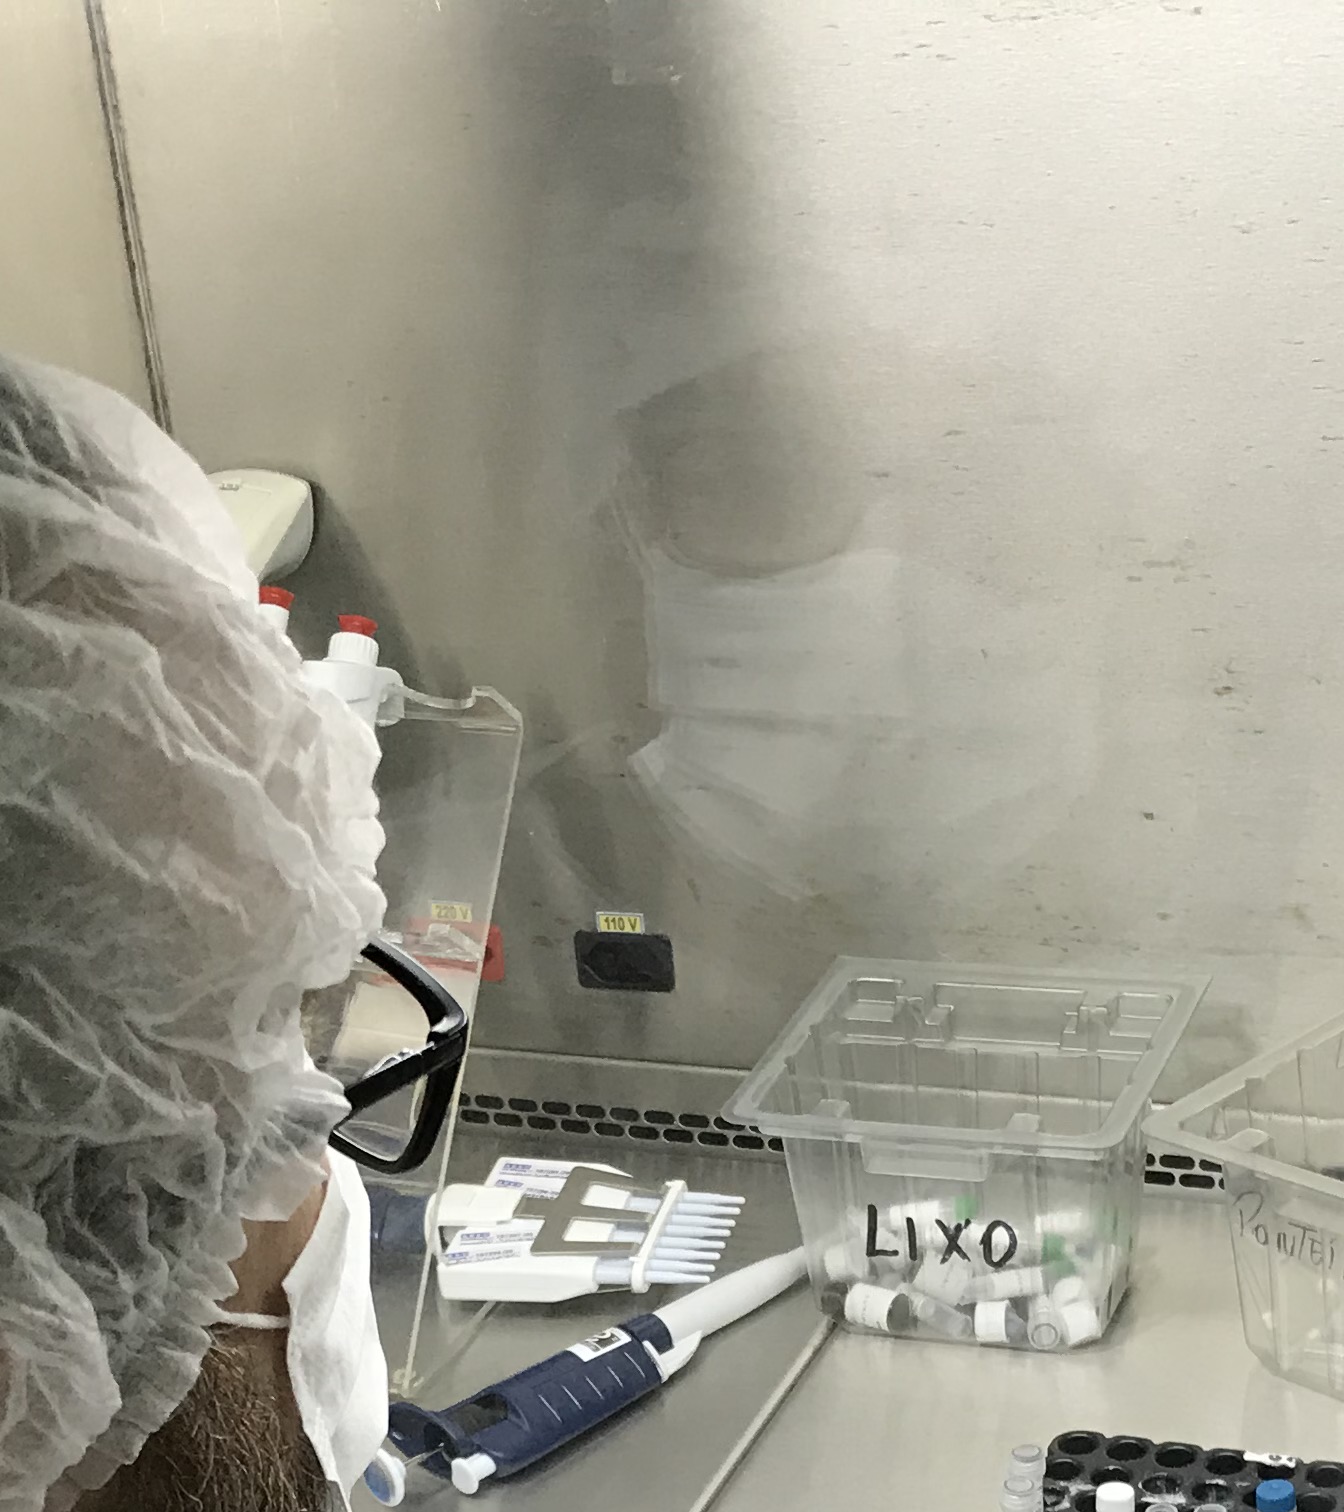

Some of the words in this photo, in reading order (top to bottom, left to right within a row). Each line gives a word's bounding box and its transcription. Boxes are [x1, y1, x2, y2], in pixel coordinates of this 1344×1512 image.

[435, 904, 457, 919] 220
[459, 907, 469, 920] V
[603, 916, 625, 931] 110
[627, 917, 638, 932] V
[866, 1203, 1018, 1268] LIXO
